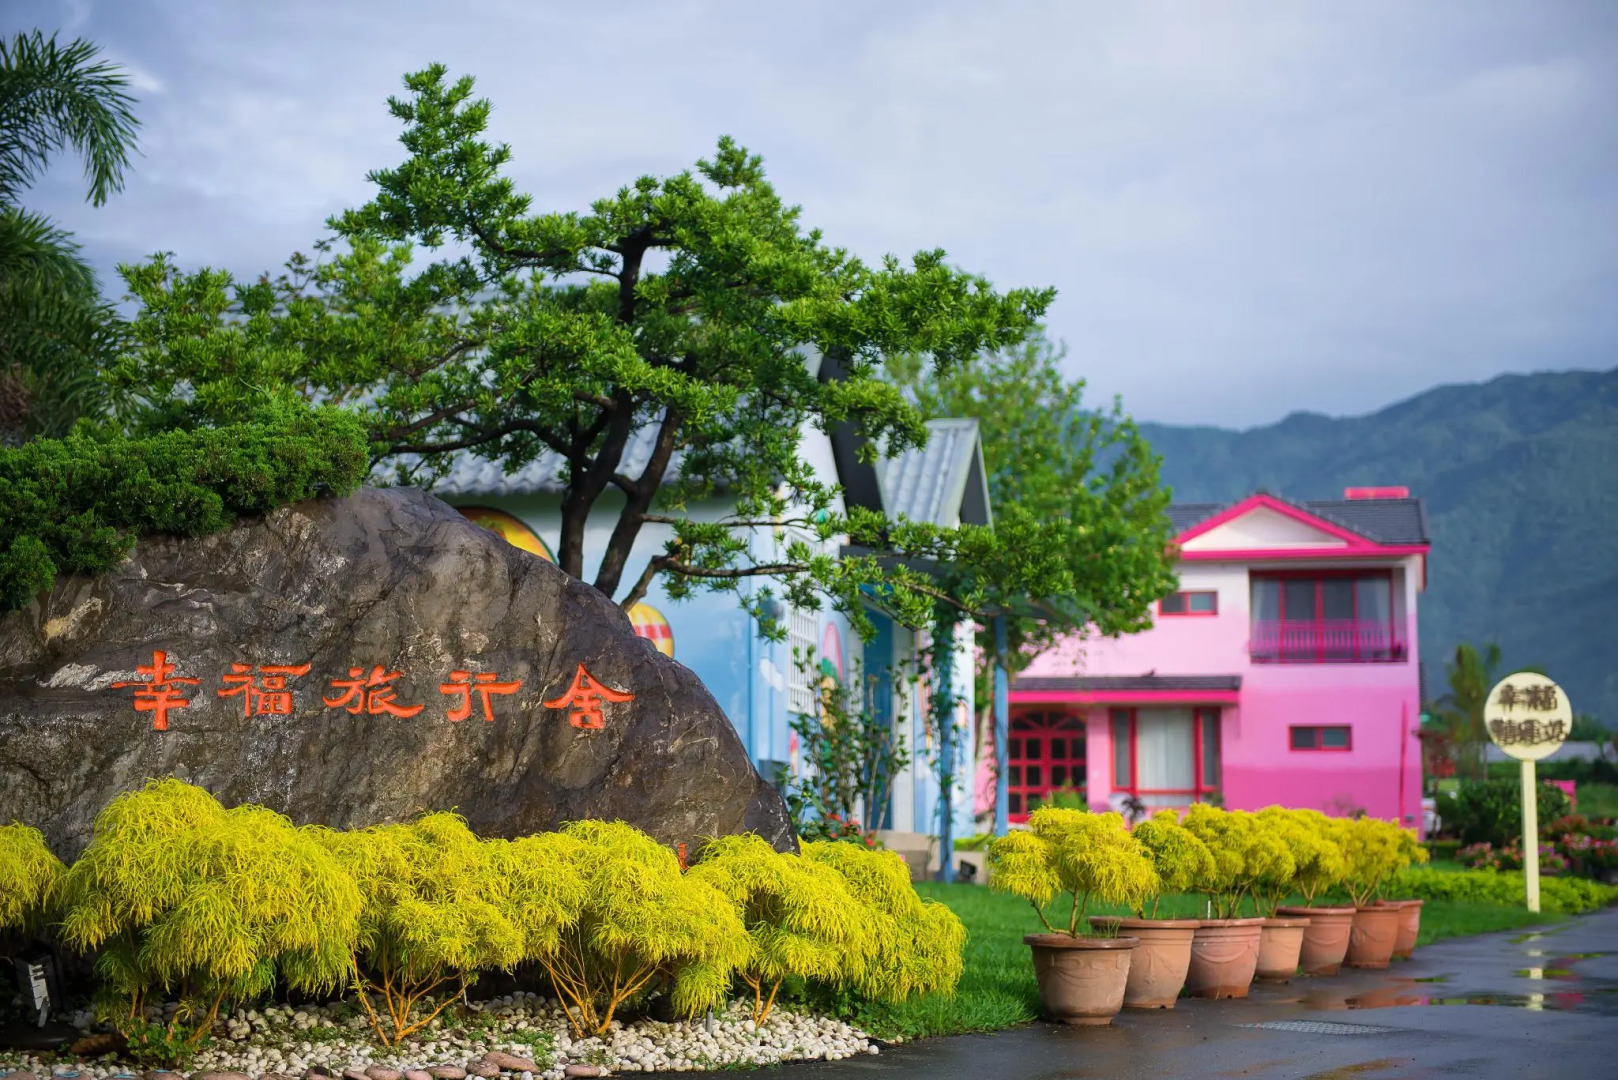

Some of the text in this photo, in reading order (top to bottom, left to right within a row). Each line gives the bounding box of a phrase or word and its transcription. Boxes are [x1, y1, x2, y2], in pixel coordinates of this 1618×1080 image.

[111, 649, 635, 731] 幸福旅行舍
